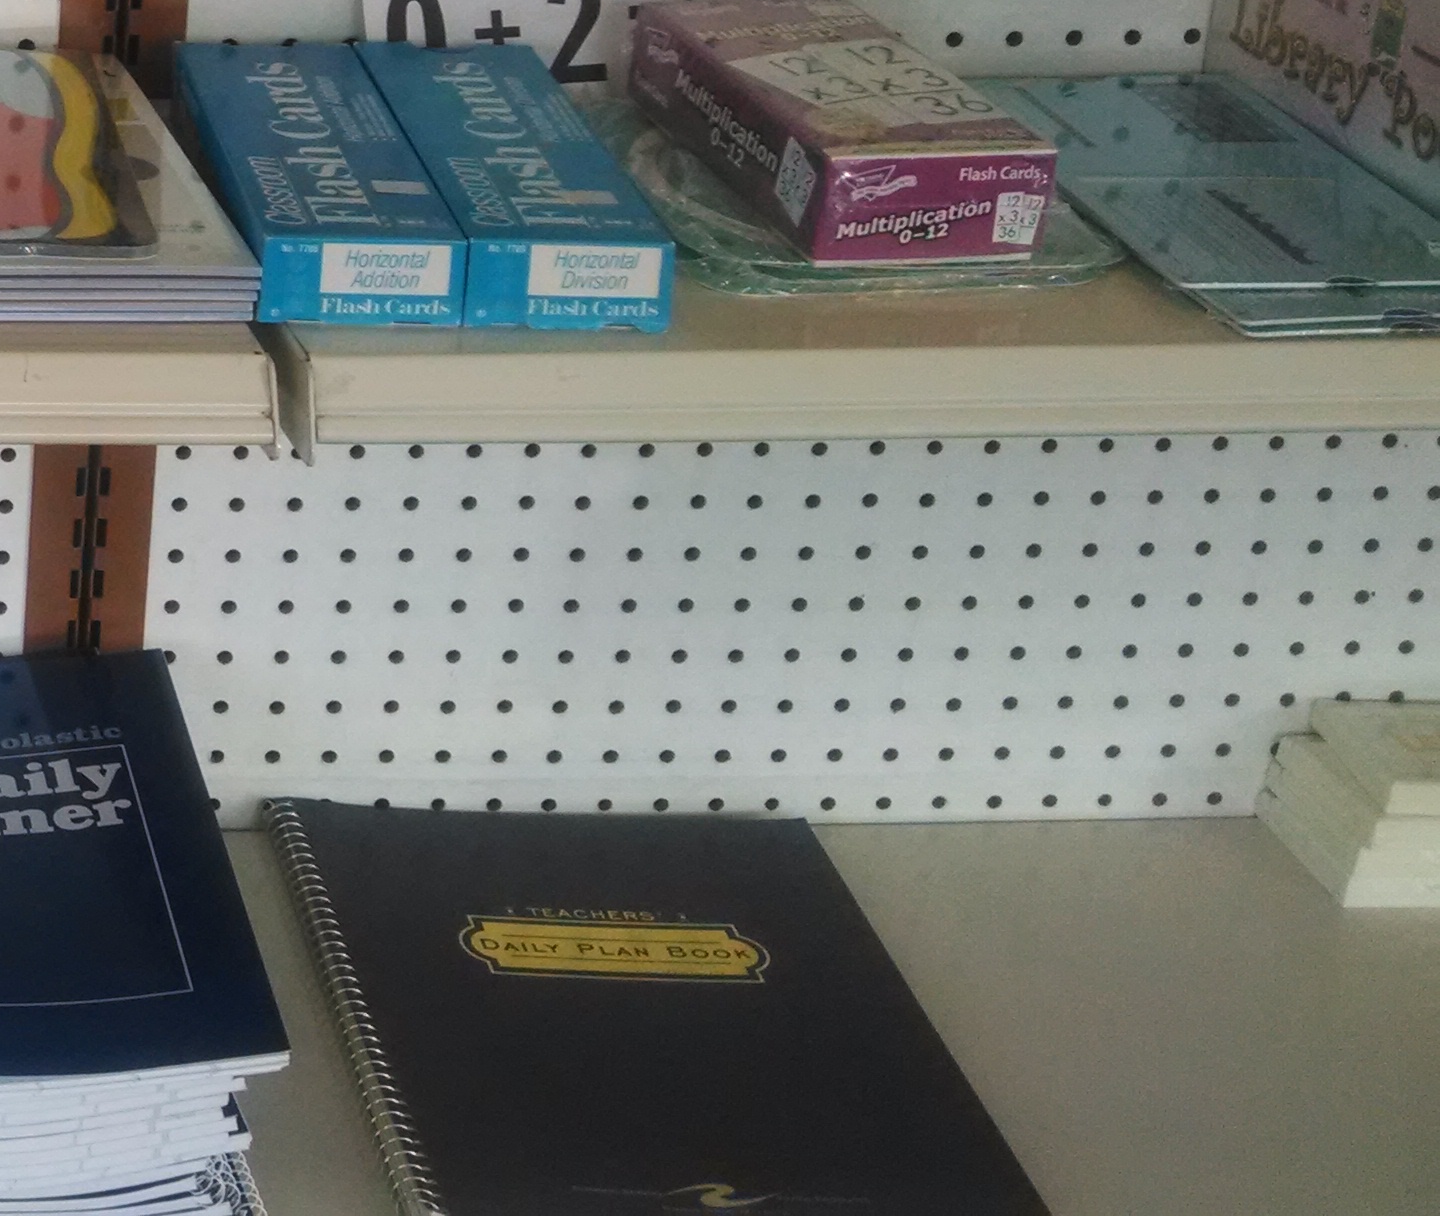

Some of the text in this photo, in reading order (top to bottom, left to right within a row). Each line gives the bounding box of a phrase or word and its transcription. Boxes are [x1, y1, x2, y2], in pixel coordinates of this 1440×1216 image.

[245, 61, 332, 140] Cards
[432, 60, 527, 140] Cards
[674, 68, 779, 173] Multiplication
[247, 155, 308, 225] Classroom
[284, 145, 383, 226] Flash
[445, 156, 516, 227] Classroom
[483, 146, 594, 228] Flash
[958, 164, 1042, 183] Flash Cards
[834, 198, 993, 241] Multiplication
[344, 249, 432, 269] Horizontal
[349, 270, 421, 290] Addition
[553, 250, 642, 271] Horizontal
[560, 271, 629, 291] Division
[320, 297, 451, 317] Flash Cards
[527, 298, 660, 318] Flash Cards
